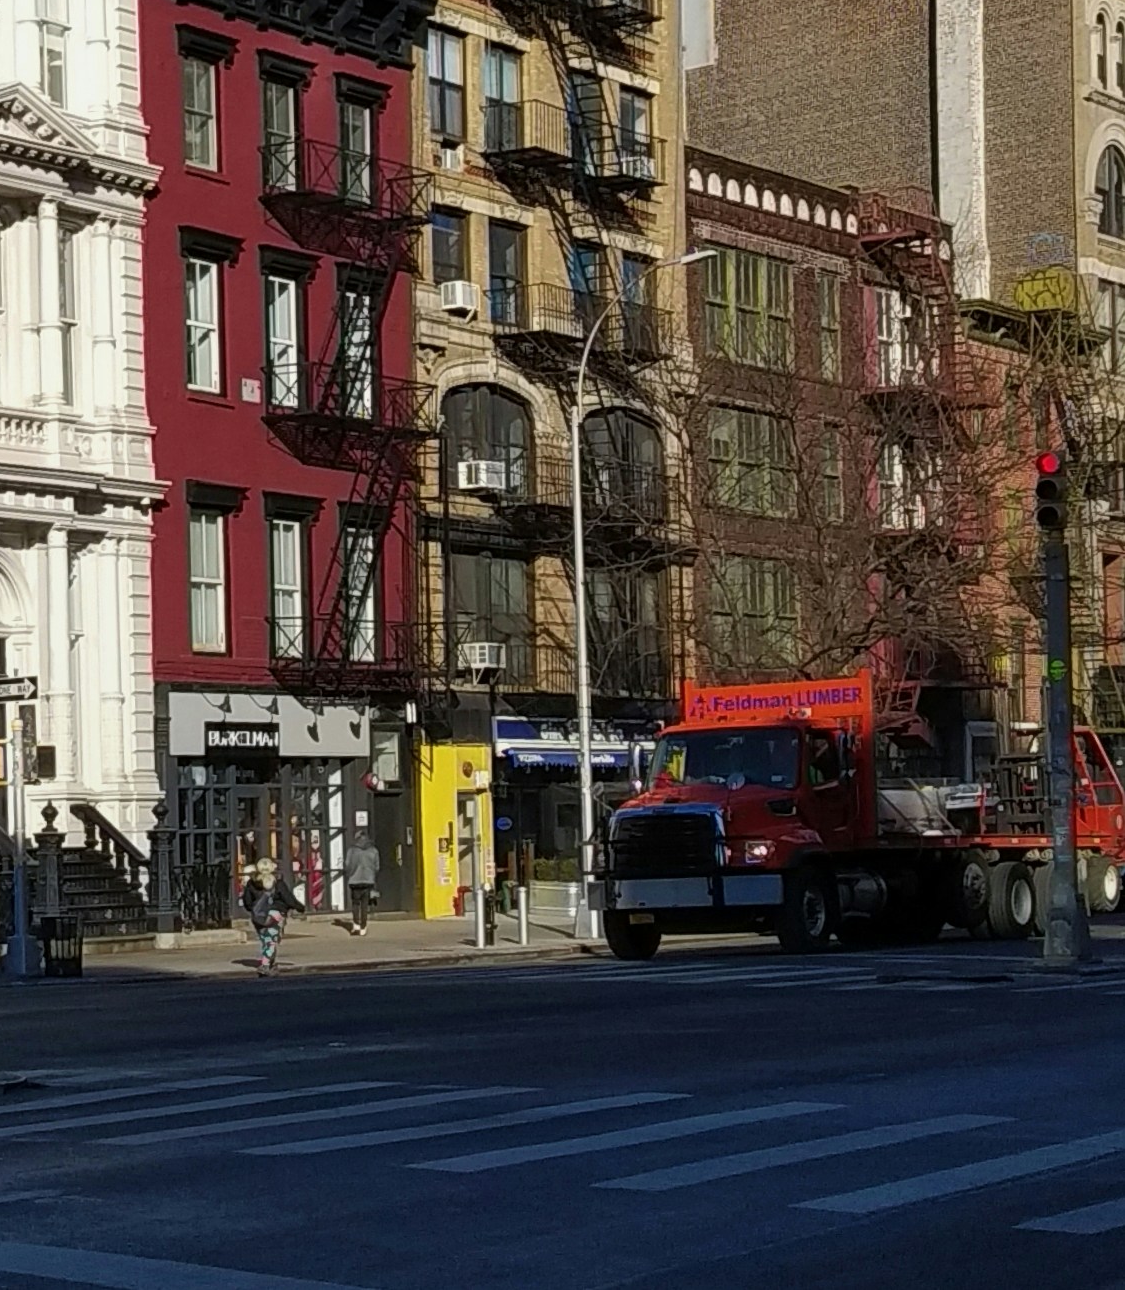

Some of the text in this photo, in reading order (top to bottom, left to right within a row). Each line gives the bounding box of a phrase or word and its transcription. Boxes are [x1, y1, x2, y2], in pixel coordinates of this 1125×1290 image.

[17, 684, 31, 694] WAY
[712, 687, 863, 713] Feldman LUMBER
[208, 730, 279, 747] BURKELMAN
